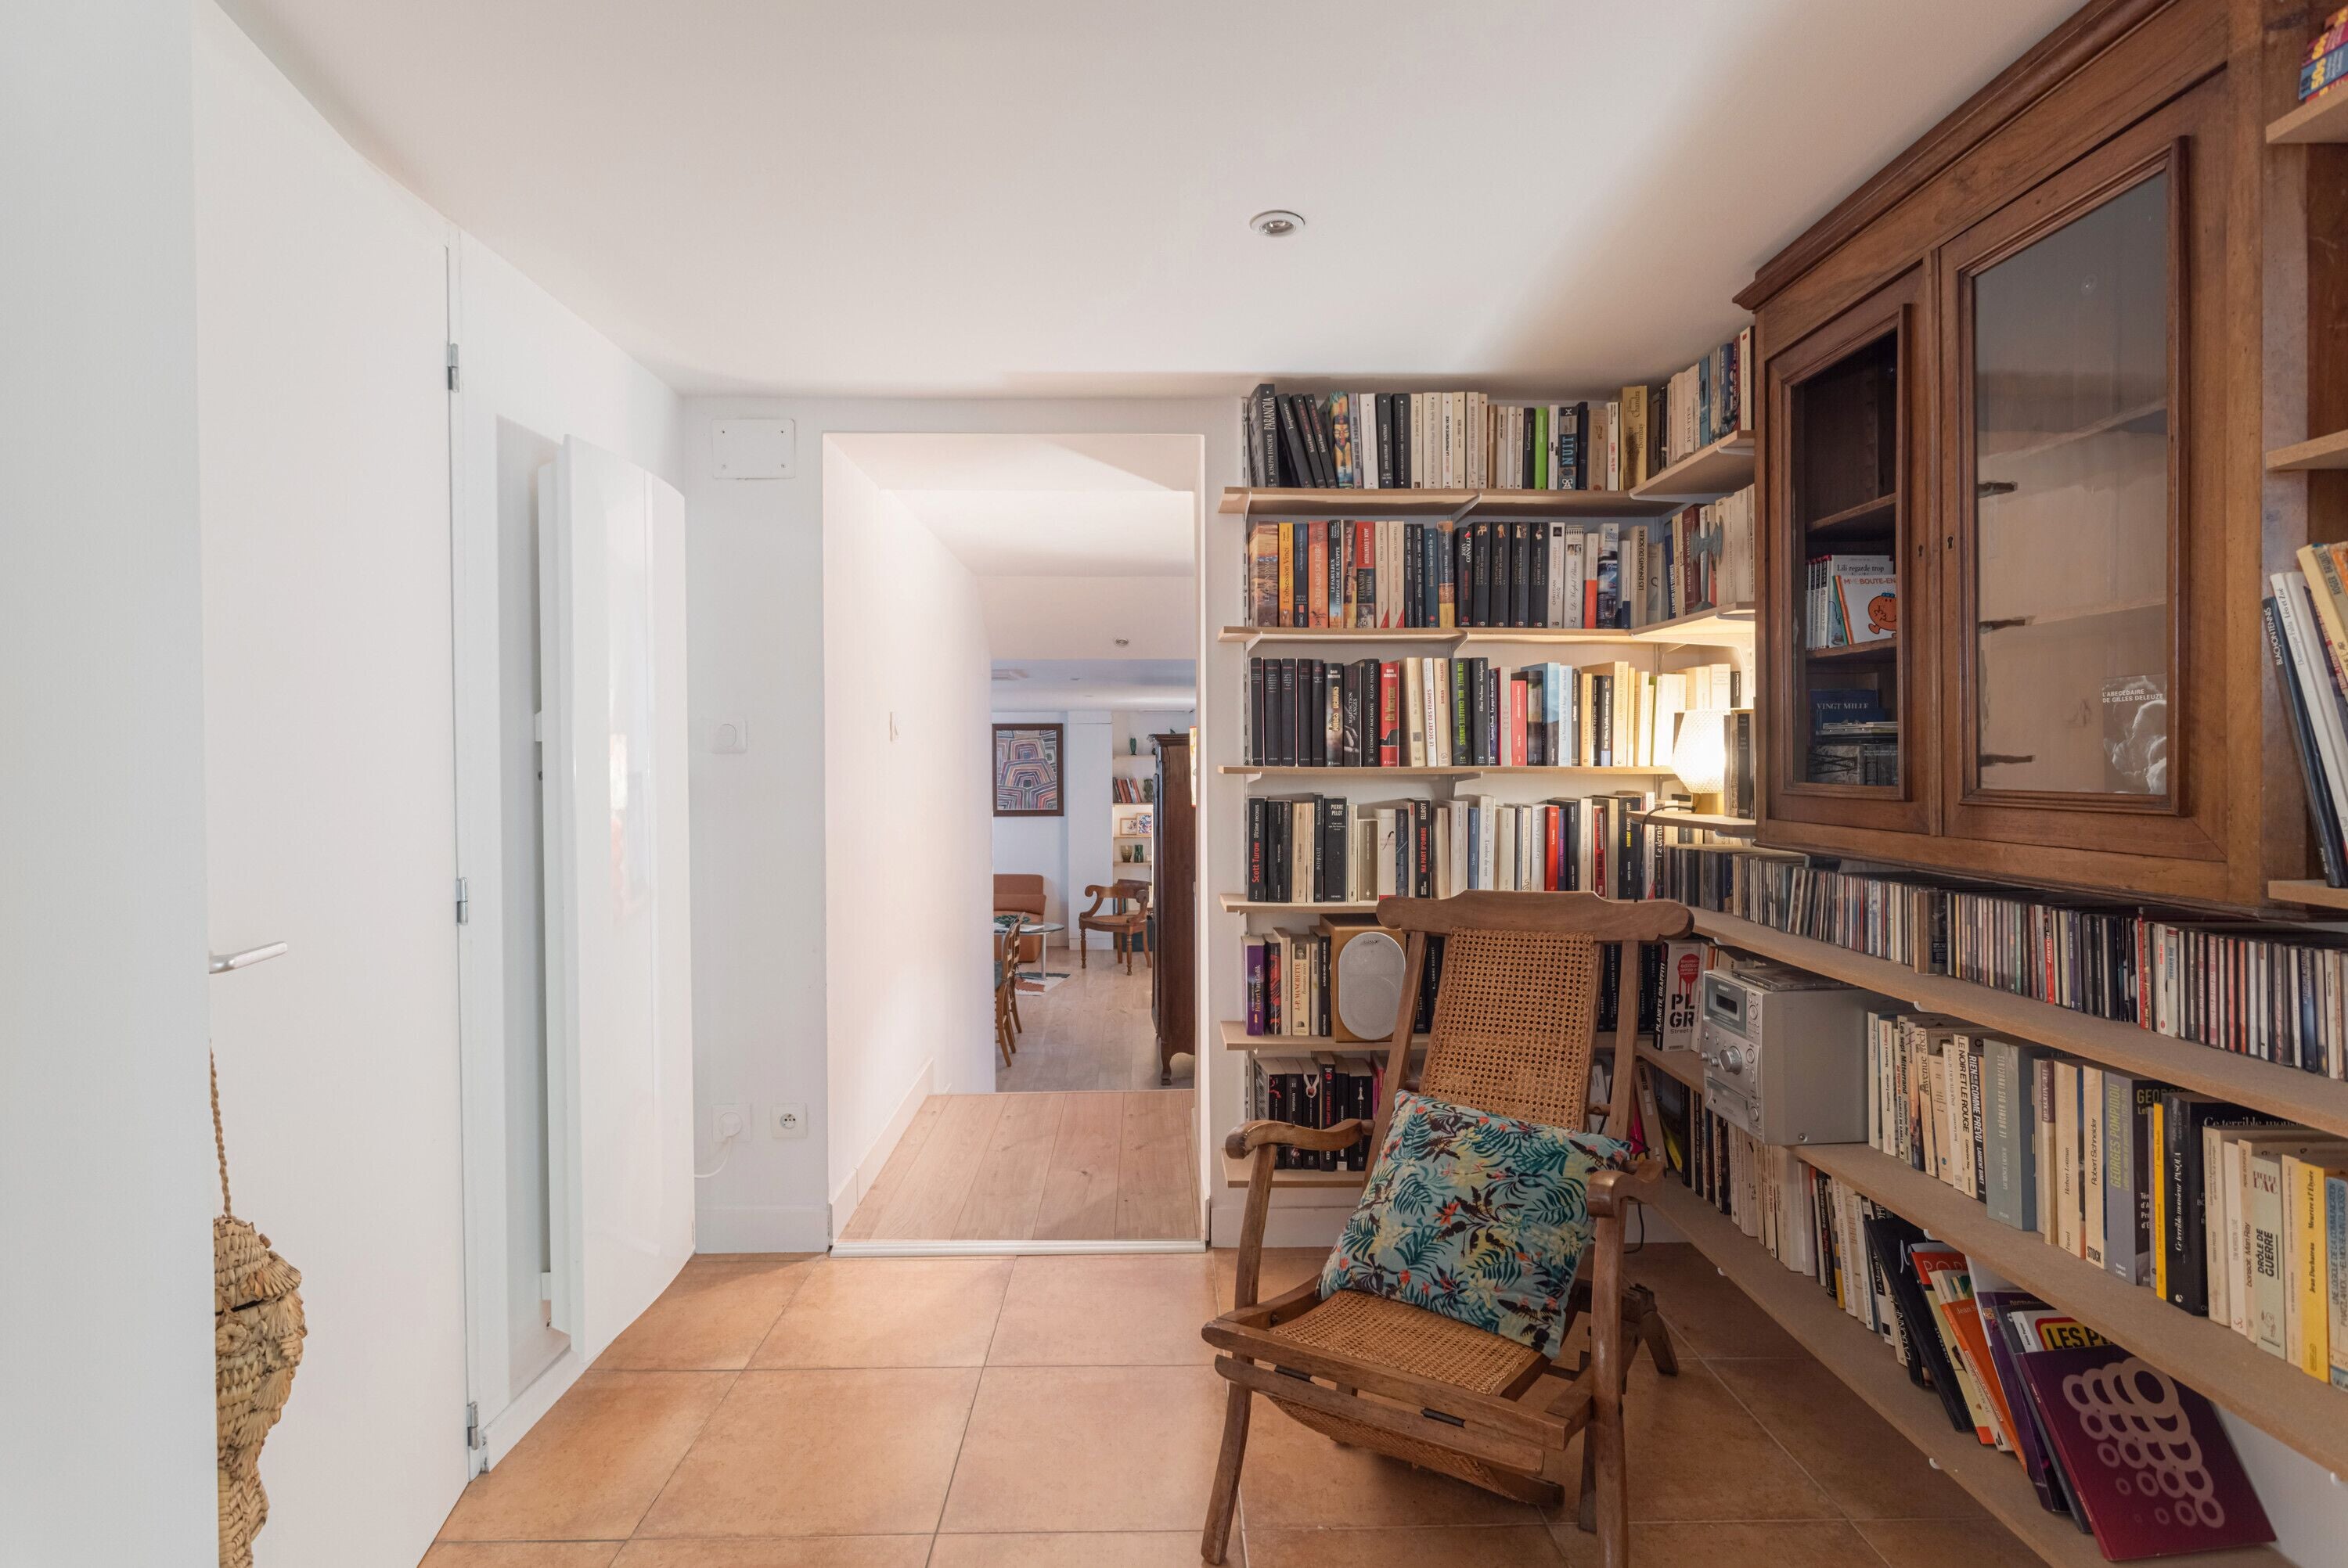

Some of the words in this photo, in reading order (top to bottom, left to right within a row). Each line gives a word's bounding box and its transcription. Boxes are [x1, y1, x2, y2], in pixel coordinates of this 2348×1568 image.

[1262, 397, 1275, 430] PARANOIA
[1631, 390, 1640, 418] Chandra
[1562, 437, 1574, 465] NUIT
[1849, 565, 1871, 574] regarde
[1421, 865, 1426, 873] MA
[1958, 1037, 1966, 1048] LE
[1968, 1056, 1977, 1074] RIEN
[1961, 1086, 1968, 1098] LE
[1971, 1084, 1980, 1113] COMME
[1961, 1099, 1970, 1133] ROUGE
[2109, 1084, 2120, 1137] POMPIDOU
[1973, 1115, 1983, 1142] PRÉVU
[2109, 1138, 2121, 1189] GEORGES
[2173, 1153, 2184, 1183] PASQUA
[2174, 1184, 2184, 1214] monsieur
[2174, 1214, 2184, 1239] terrible
[2255, 1228, 2263, 1240] DE
[2087, 1246, 2101, 1264] STOCK
[2175, 1240, 2184, 1252] Ce
[2255, 1241, 2264, 1274] DRÔLE
[2263, 1231, 2274, 1278] GUERRE
[1955, 1306, 1970, 1315] Jean
[2046, 1325, 2083, 1350] LES
[1904, 1346, 1911, 1361] LA
